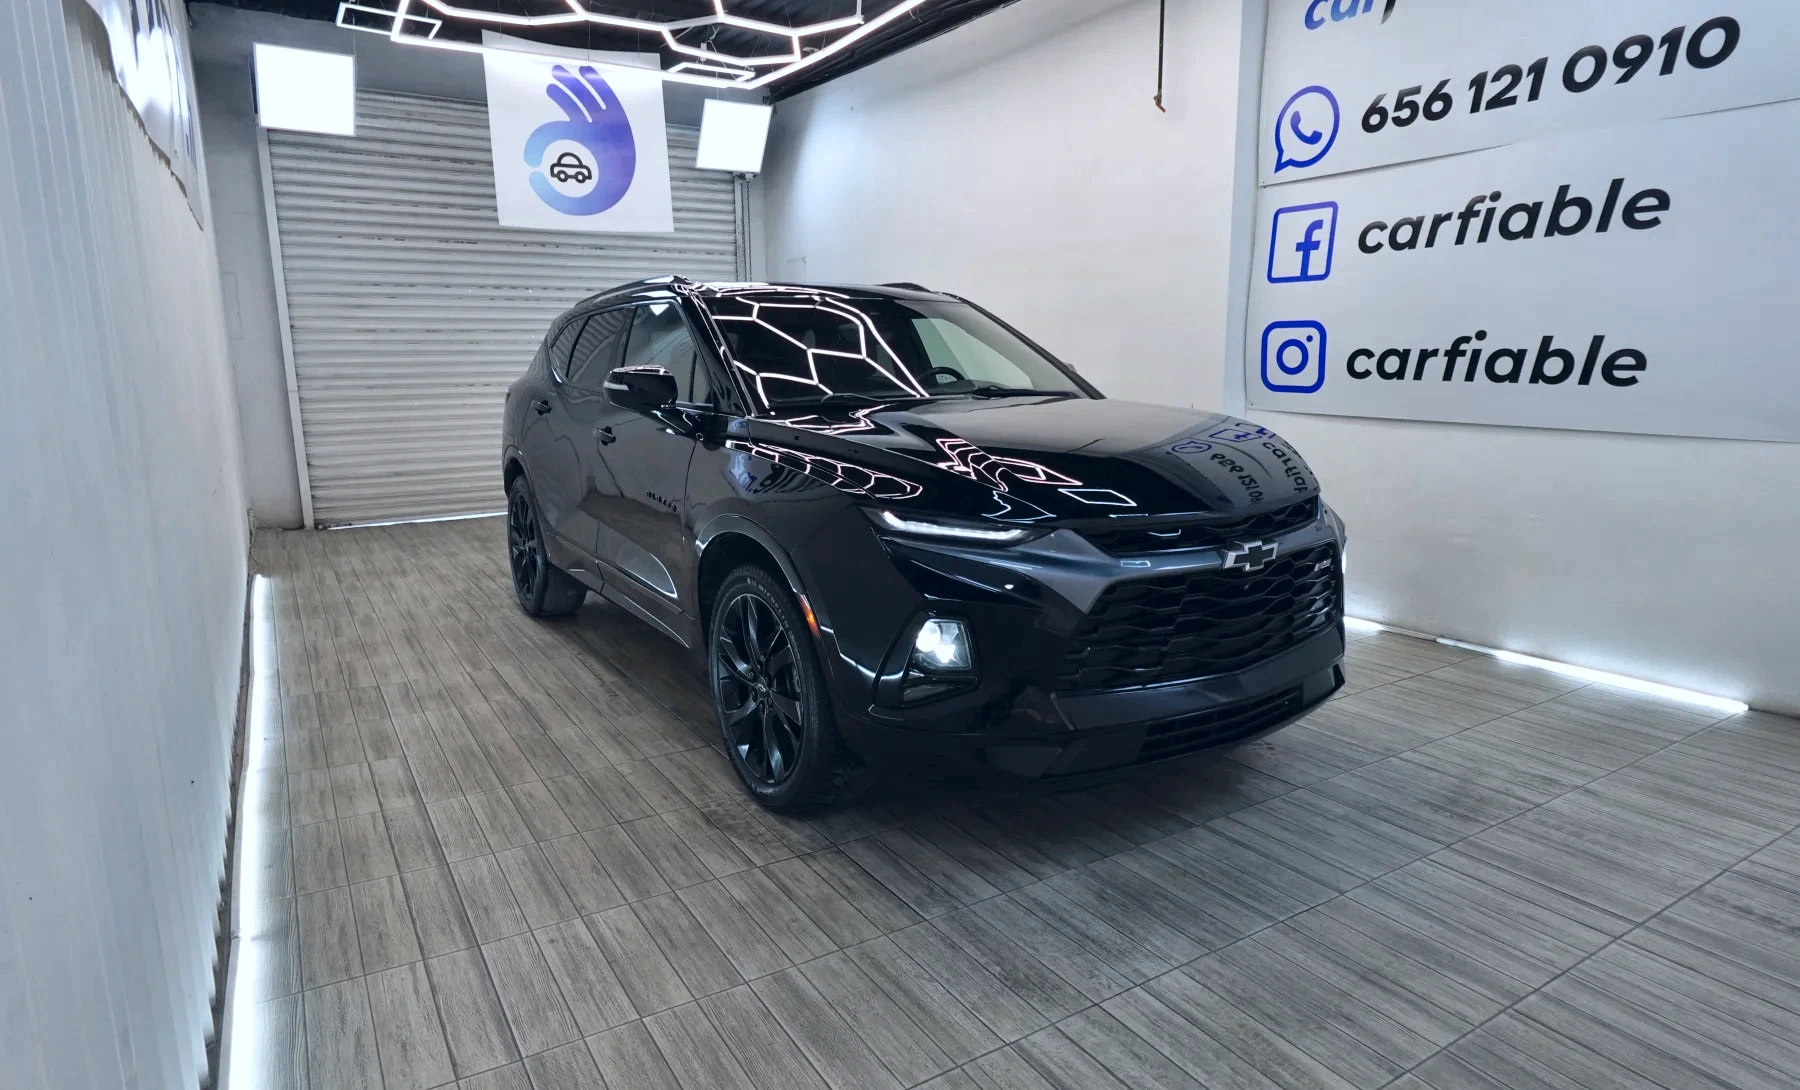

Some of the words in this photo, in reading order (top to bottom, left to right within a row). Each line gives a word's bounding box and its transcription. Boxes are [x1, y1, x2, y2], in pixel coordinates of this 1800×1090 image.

[1360, 79, 1454, 134] 656
[1468, 57, 1549, 114] 121
[1562, 16, 1741, 93] 0910
[1358, 178, 1671, 254] carfiable
[1346, 330, 1648, 388] carfiable
